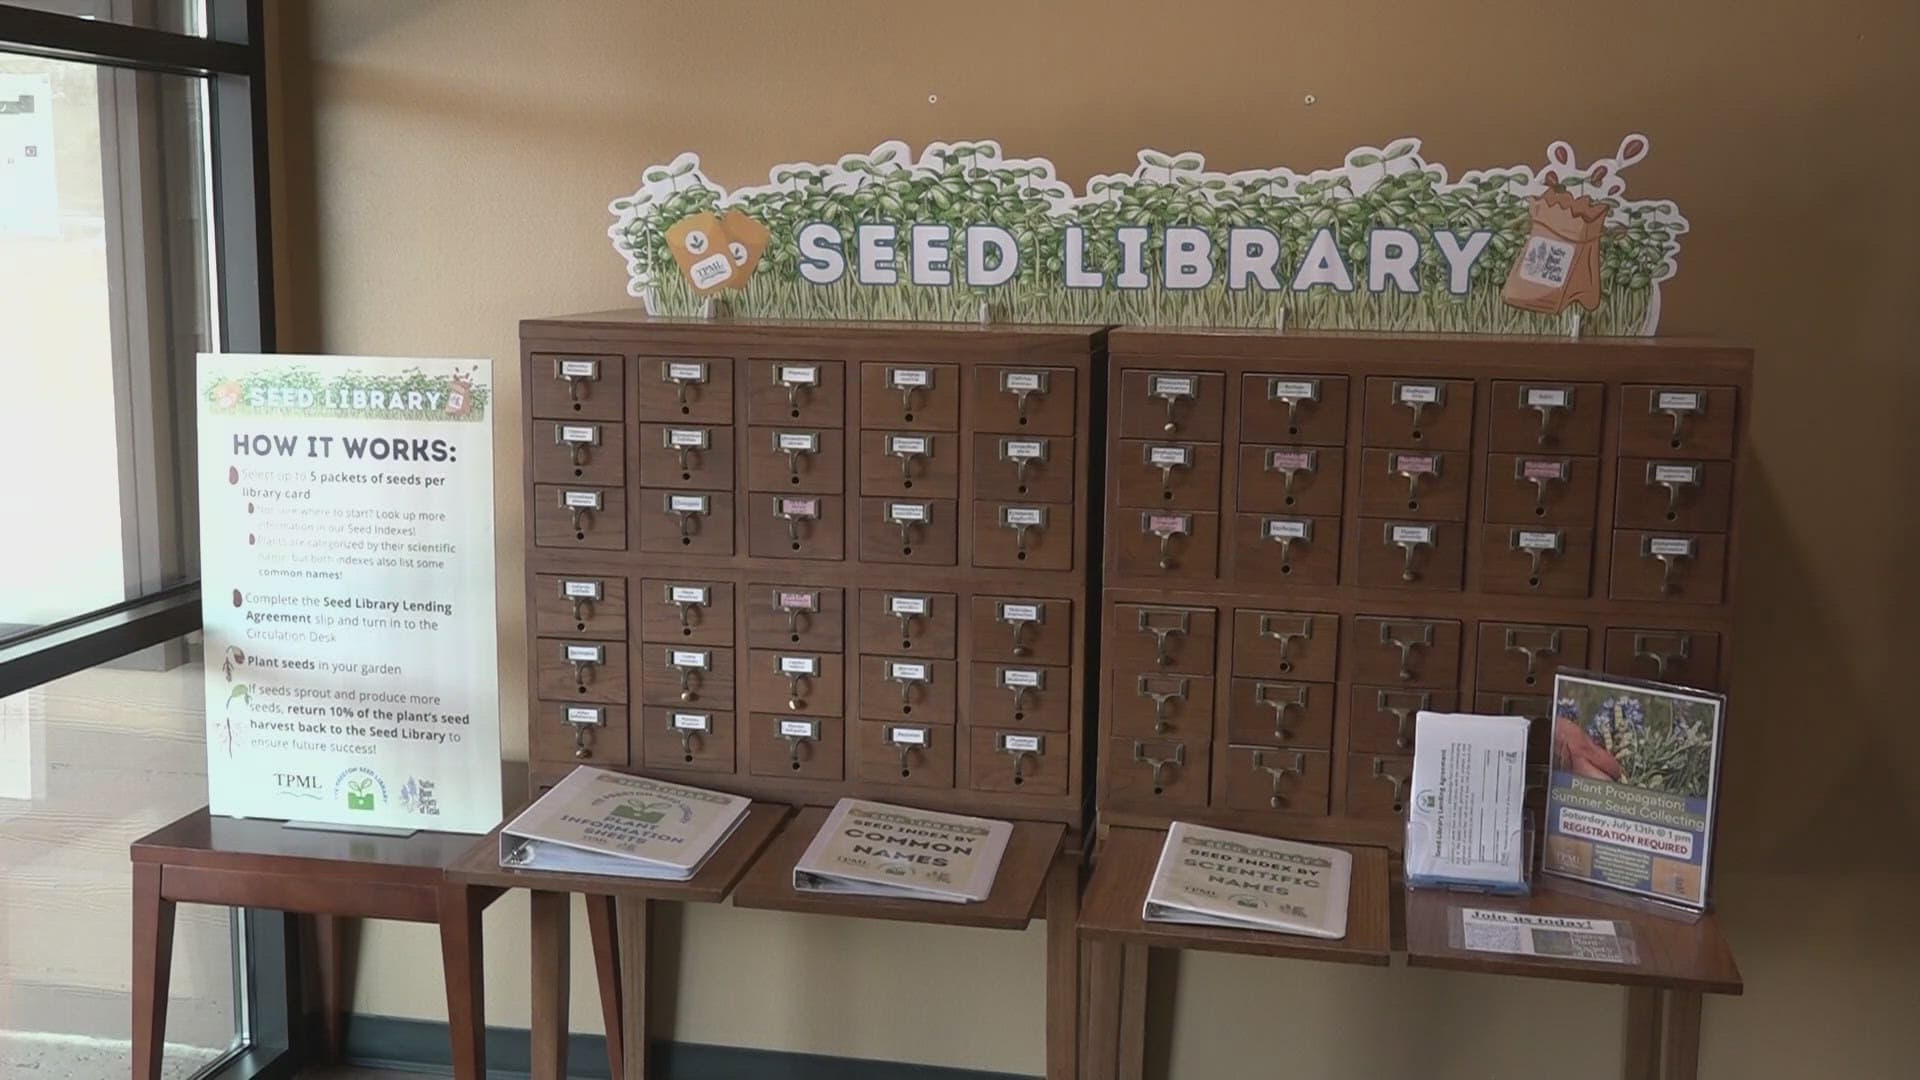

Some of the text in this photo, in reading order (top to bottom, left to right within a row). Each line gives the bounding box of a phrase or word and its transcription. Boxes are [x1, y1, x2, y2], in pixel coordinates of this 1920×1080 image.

[799, 222, 1494, 294] SEED LIBRARY
[250, 387, 314, 409] SEED
[325, 389, 441, 411] LIBRARY
[233, 434, 457, 463] HOW IT WORKS:
[310, 471, 317, 482] 5
[321, 472, 367, 484] packets
[370, 473, 383, 484] of
[386, 474, 421, 486] seeds
[425, 477, 446, 489] per
[242, 487, 311, 501] library card
[376, 510, 400, 521] Look
[403, 512, 416, 523] up
[418, 512, 446, 522] more
[347, 523, 372, 535] Seed
[375, 524, 416, 537] Indexes!
[367, 541, 378, 552] by
[381, 542, 404, 552] their
[408, 543, 457, 554] scientific
[337, 555, 374, 567] indexes
[377, 556, 397, 567] also
[399, 557, 414, 568] list
[416, 560, 445, 569] some
[258, 569, 344, 581] common names!
[245, 592, 452, 616] Complete the Seed Library Lending
[246, 610, 439, 631] Agreement slip and turn in to the
[247, 628, 337, 643] Circulation Desk
[247, 655, 402, 677] Plant seeds in your garden
[249, 683, 441, 706] If seeds sprout and produce more
[249, 702, 470, 727] seeds, return 10% of the plant’s seed
[249, 719, 462, 744] harvest back to the Seed Library to
[251, 737, 378, 755] ensure future success!
[273, 772, 322, 790] TPML
[1434, 748, 1448, 856] Seed Library Lending Agreement
[1571, 777, 1686, 811] Plant Propagation:
[1551, 788, 1705, 833] Summer Seed Collecting
[560, 813, 685, 844] INFORMATION
[603, 814, 660, 831] PLANT
[853, 819, 893, 831] SEED
[898, 826, 950, 841] INDEX
[954, 835, 977, 844] BY
[1562, 809, 1610, 827] Saturday,
[1612, 817, 1632, 831] July
[1634, 823, 1655, 835] 13th
[1656, 827, 1666, 838] @
[1674, 834, 1691, 844] pm
[583, 826, 647, 845] SHEETS
[844, 828, 973, 856] COMMON
[1562, 821, 1688, 855] REGISTRATION REQUIRED
[853, 845, 949, 867] NAMES
[1190, 849, 1232, 861] SEED
[1237, 857, 1292, 873] INDEX
[1298, 867, 1320, 877] BY
[1184, 858, 1321, 889] SCIENTIFIC
[1208, 874, 1289, 896] NAMES
[1471, 911, 1593, 930] Join us today!
